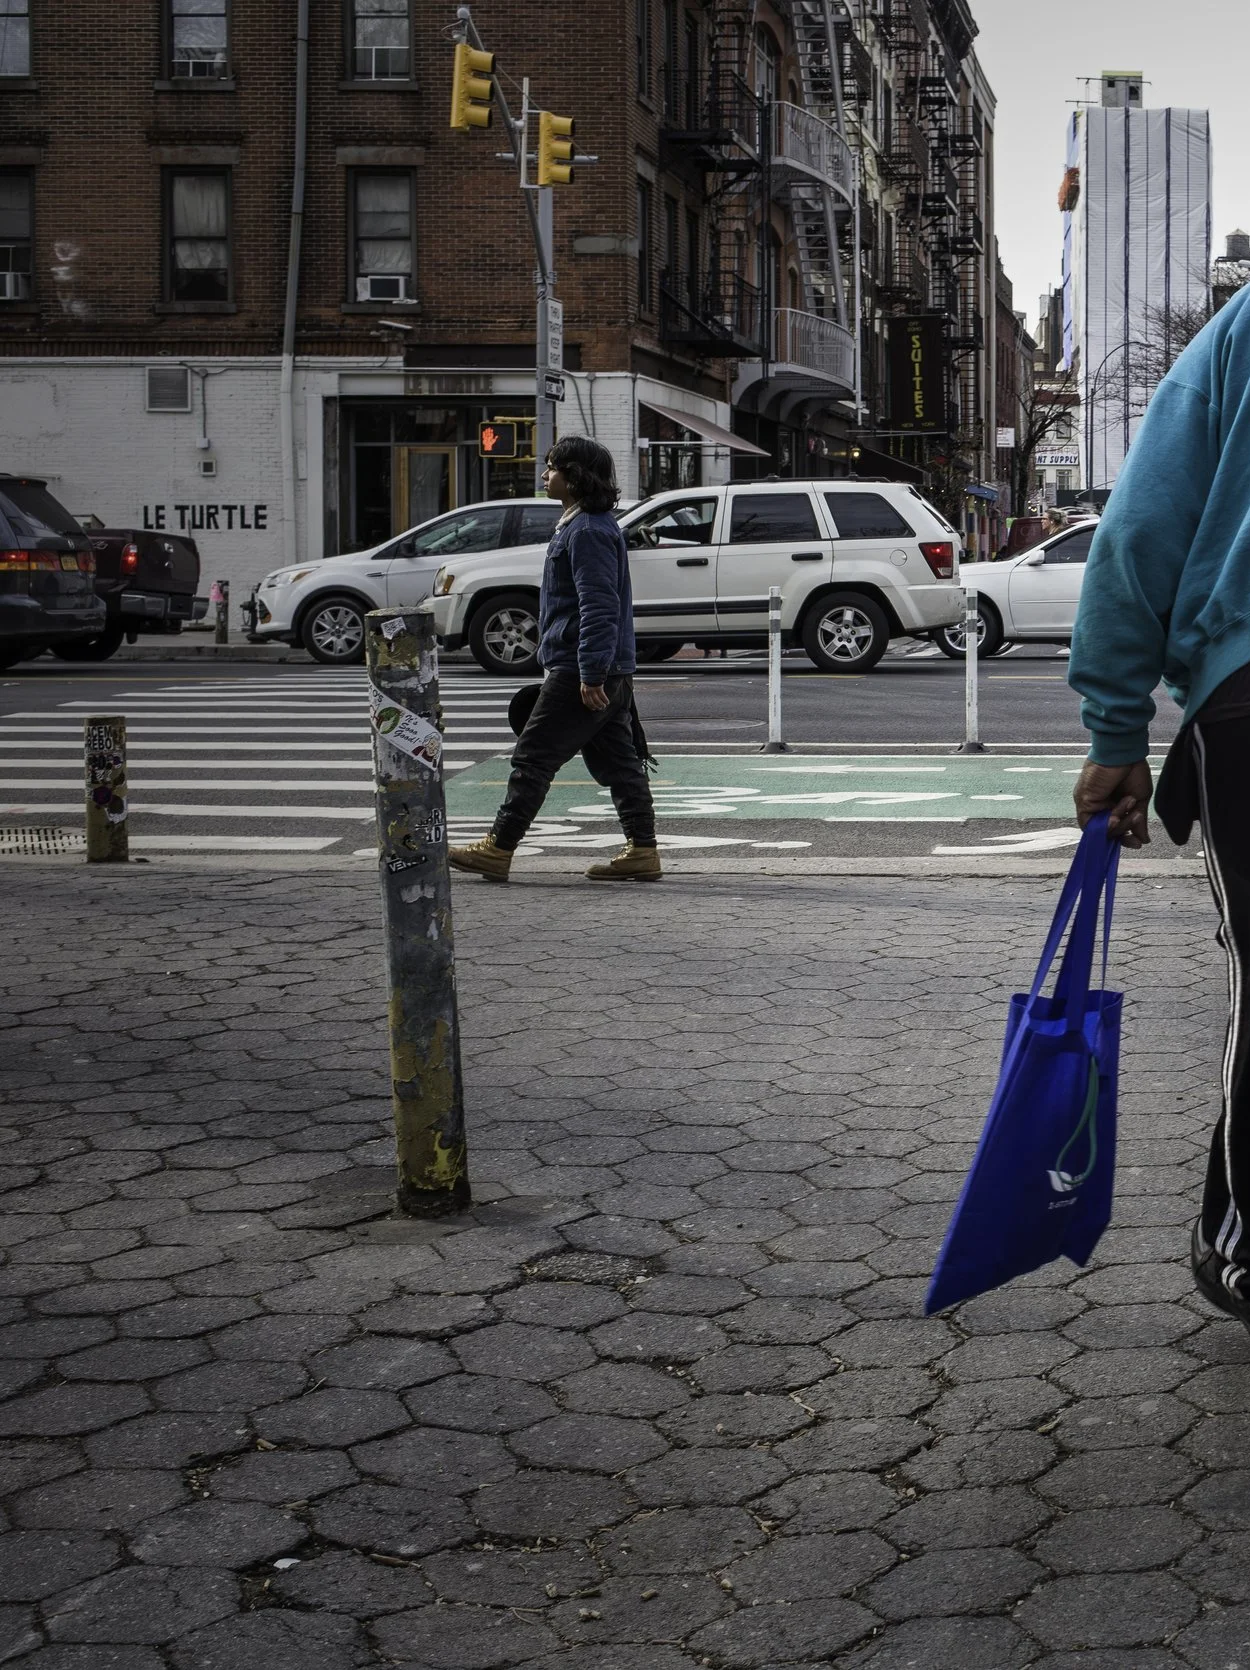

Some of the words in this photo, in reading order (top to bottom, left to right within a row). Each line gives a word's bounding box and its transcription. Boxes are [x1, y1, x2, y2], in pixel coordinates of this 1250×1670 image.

[910, 334, 924, 418] SUITES
[1049, 455, 1078, 464] SUPPLY
[143, 504, 166, 530] LE
[174, 504, 268, 531] TURTLE
